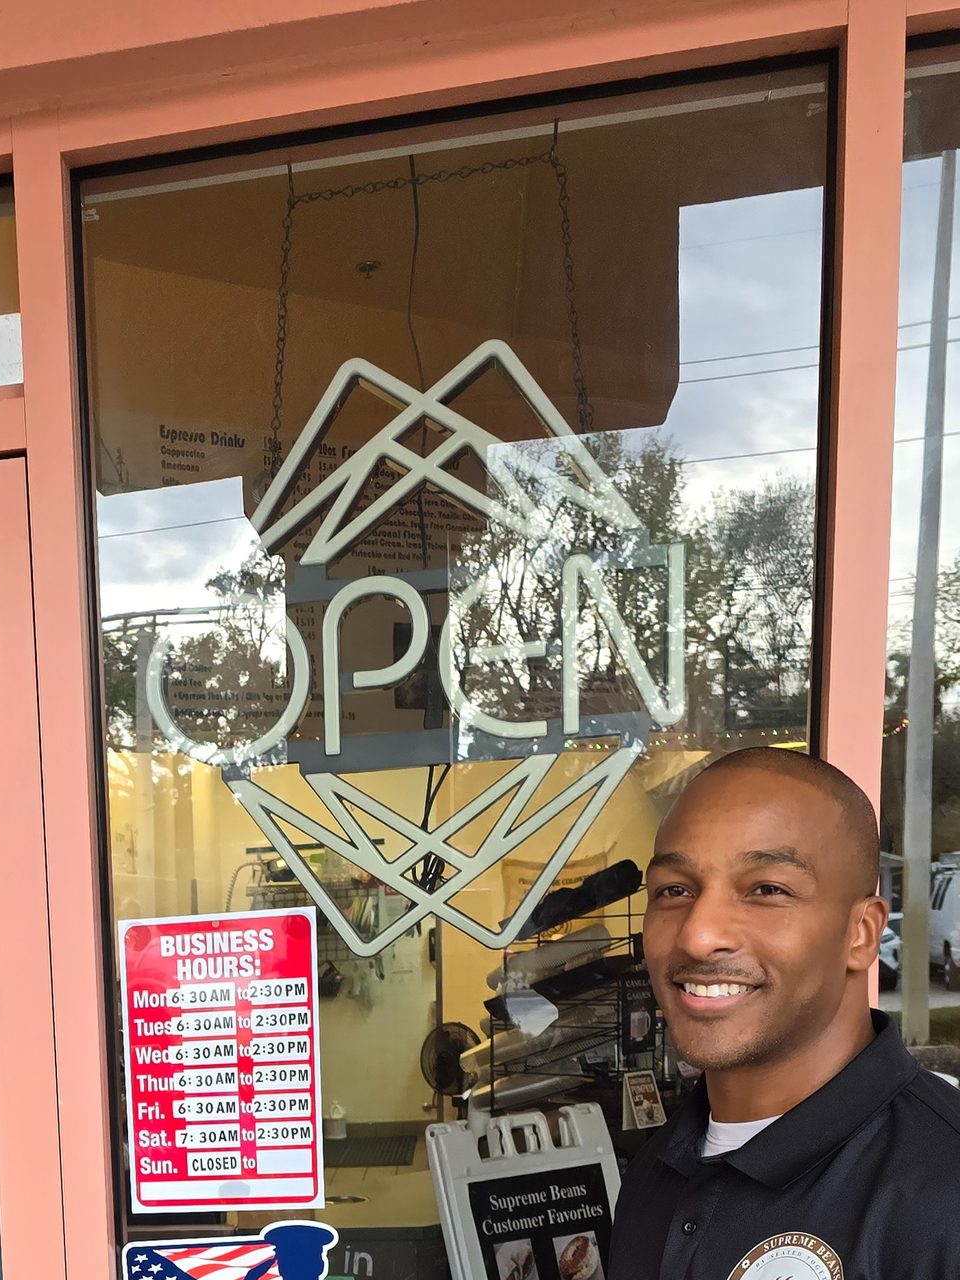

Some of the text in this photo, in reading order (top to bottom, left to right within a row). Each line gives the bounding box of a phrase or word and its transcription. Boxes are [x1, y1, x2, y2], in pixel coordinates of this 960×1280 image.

[159, 424, 246, 448] Espresso Drinks
[146, 543, 686, 764] OPEN
[160, 928, 274, 957] BUSINESS
[177, 957, 261, 981] HOURS:
[238, 1015, 251, 1029] to
[239, 1043, 252, 1057] to
[240, 1071, 253, 1085] to
[138, 1102, 165, 1120] Fri.
[240, 1099, 253, 1114] to
[139, 1130, 172, 1147] Sat.
[242, 1128, 255, 1141] to
[140, 1155, 256, 1175] Sun. CLOSED to
[489, 1184, 588, 1213] Supreme Beans
[482, 1203, 604, 1236] Customer Favorites
[763, 1235, 816, 1252] SUPREME
